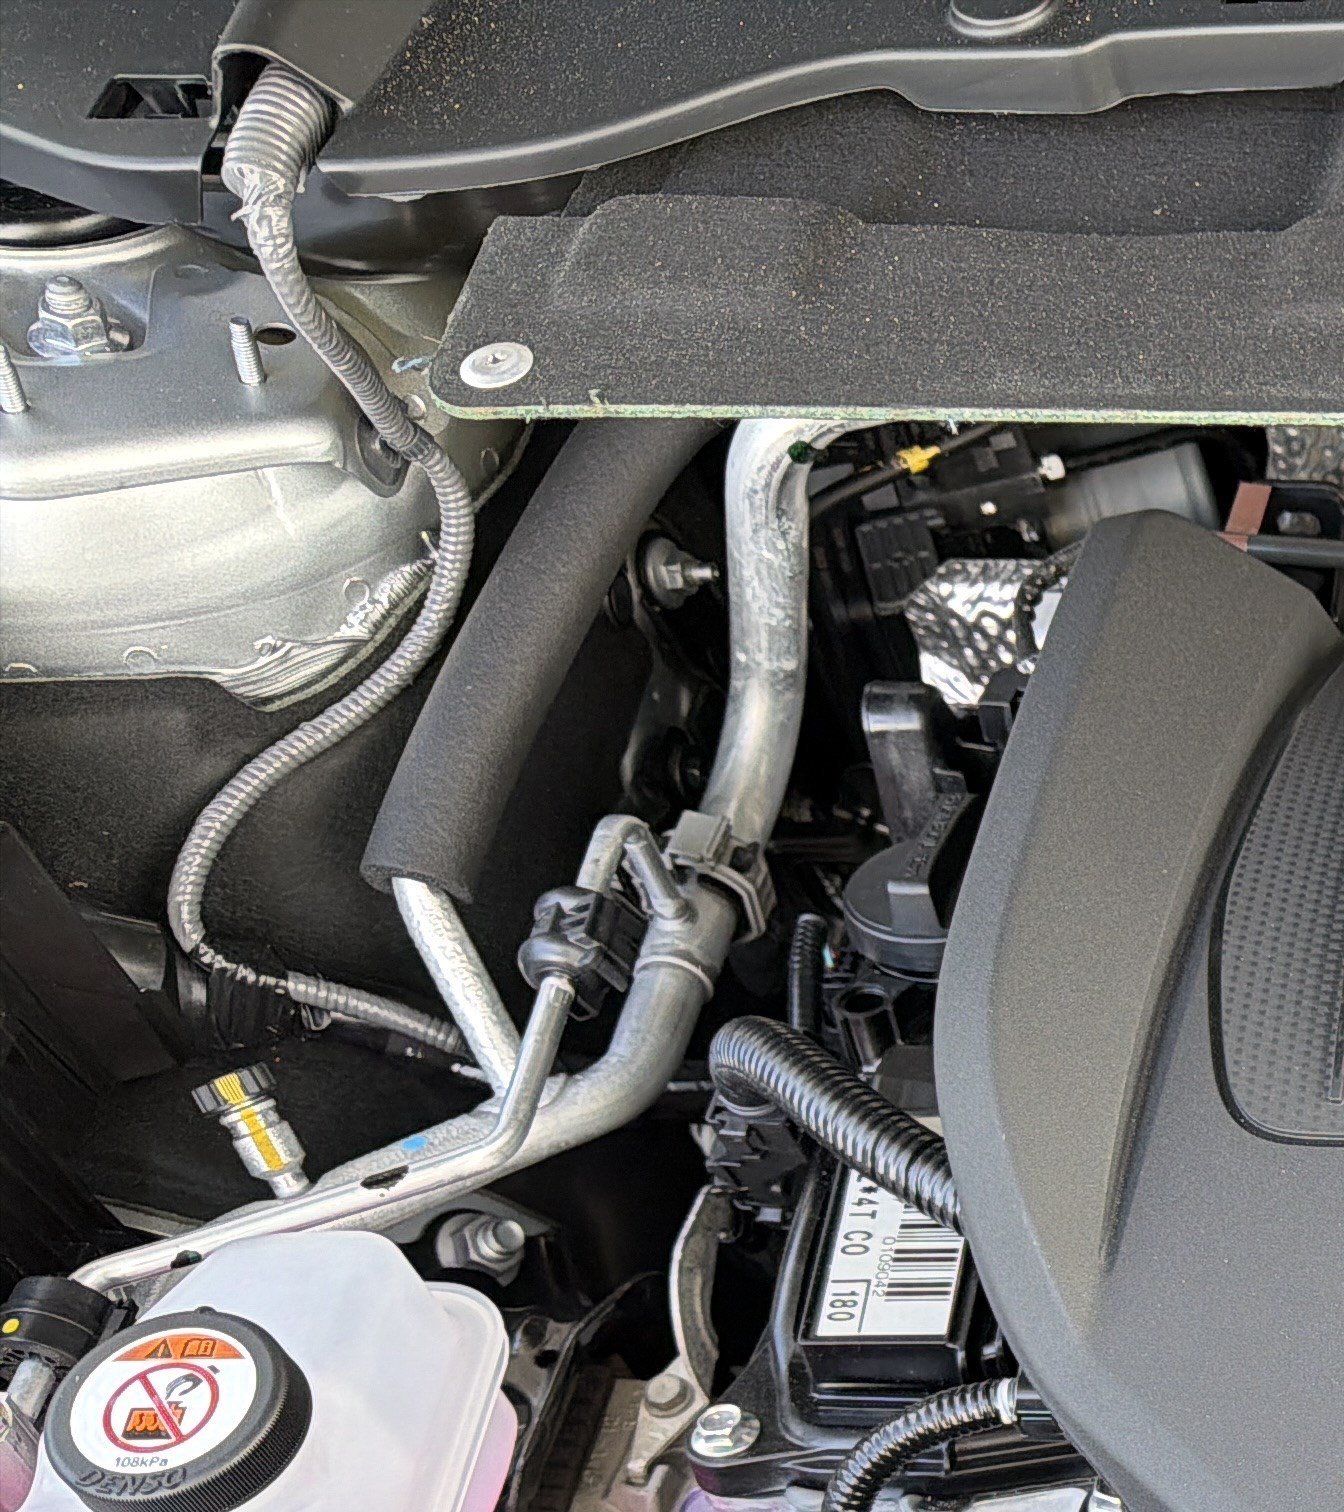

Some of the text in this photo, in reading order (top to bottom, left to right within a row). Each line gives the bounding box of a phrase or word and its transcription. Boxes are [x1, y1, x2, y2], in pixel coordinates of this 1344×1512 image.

[871, 1236, 897, 1298] 0109042
[826, 1290, 860, 1322] 180
[115, 1456, 169, 1468] 108kPa
[75, 1467, 187, 1497] DENSO
